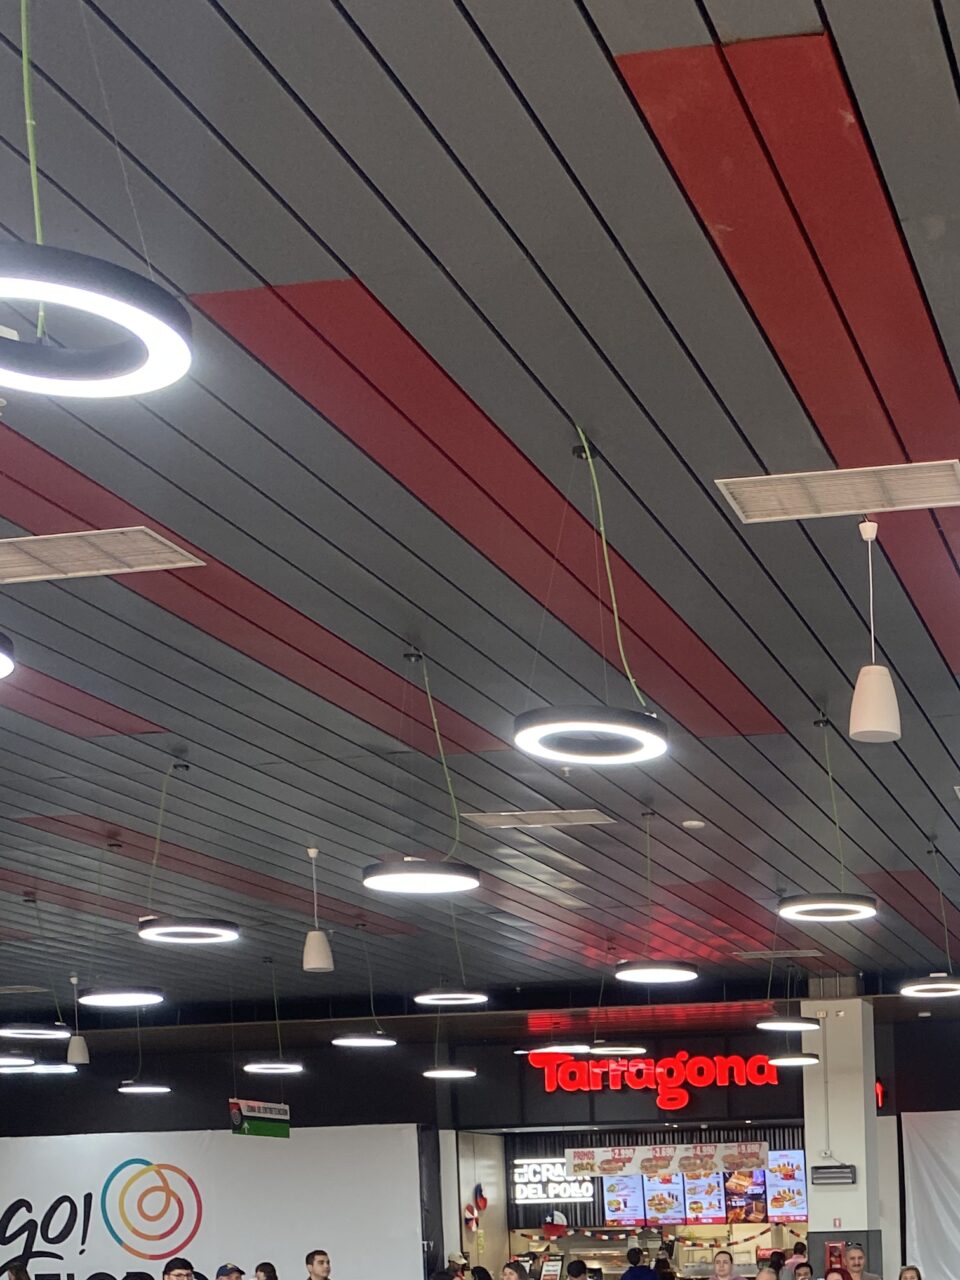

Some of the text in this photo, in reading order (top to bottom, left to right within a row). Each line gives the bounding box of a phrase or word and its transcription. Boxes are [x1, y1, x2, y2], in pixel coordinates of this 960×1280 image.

[528, 1050, 778, 1110] Tarragona
[515, 1181, 594, 1200] DEL POLLO
